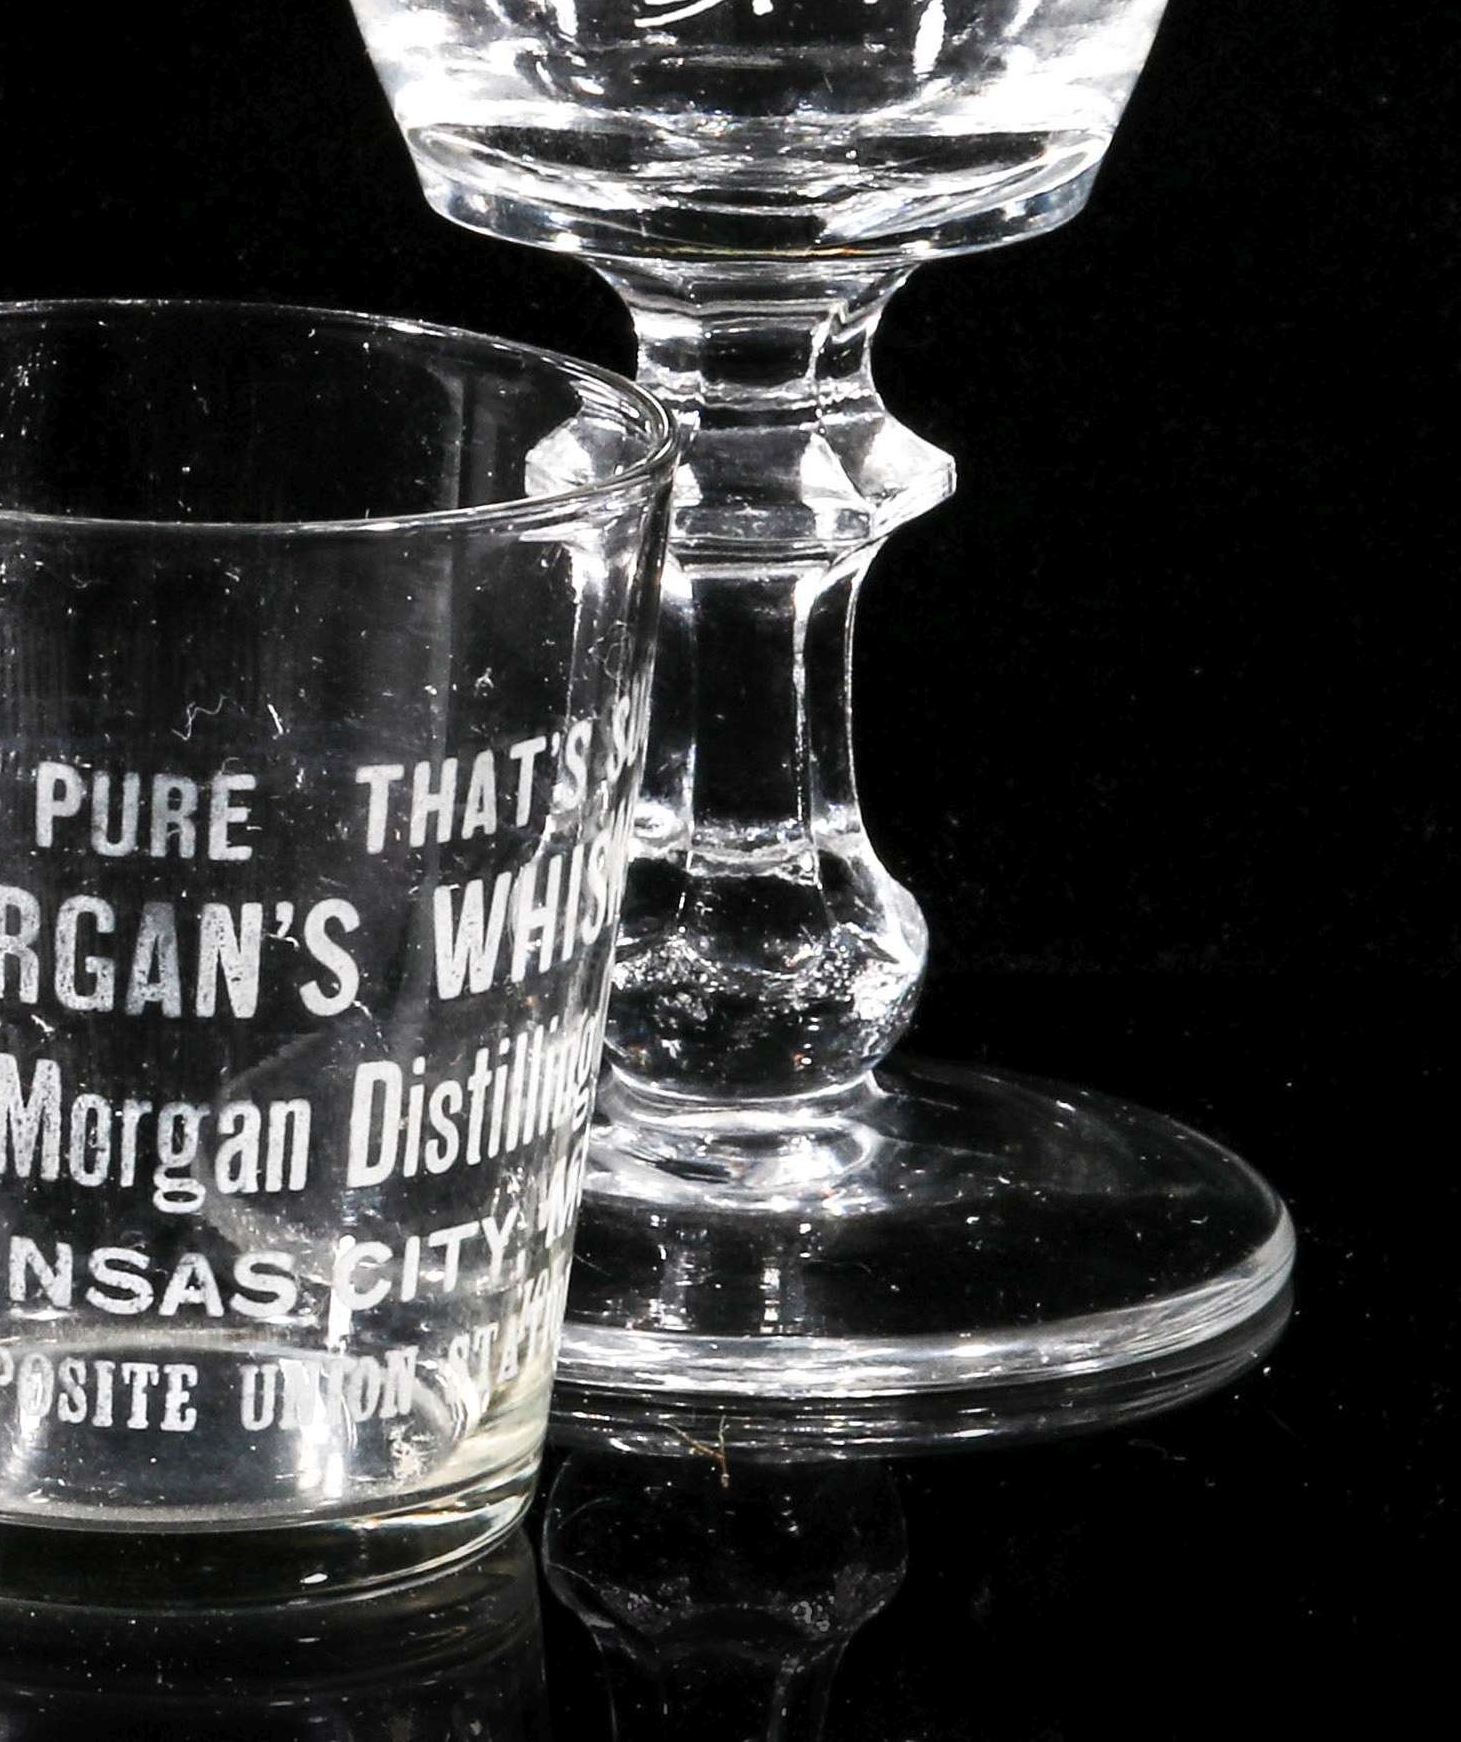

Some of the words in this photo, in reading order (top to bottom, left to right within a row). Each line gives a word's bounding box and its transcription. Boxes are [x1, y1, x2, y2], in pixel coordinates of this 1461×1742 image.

[34, 761, 259, 861] PURE
[355, 718, 593, 855] THAT'S
[240, 1345, 420, 1432] UNION
